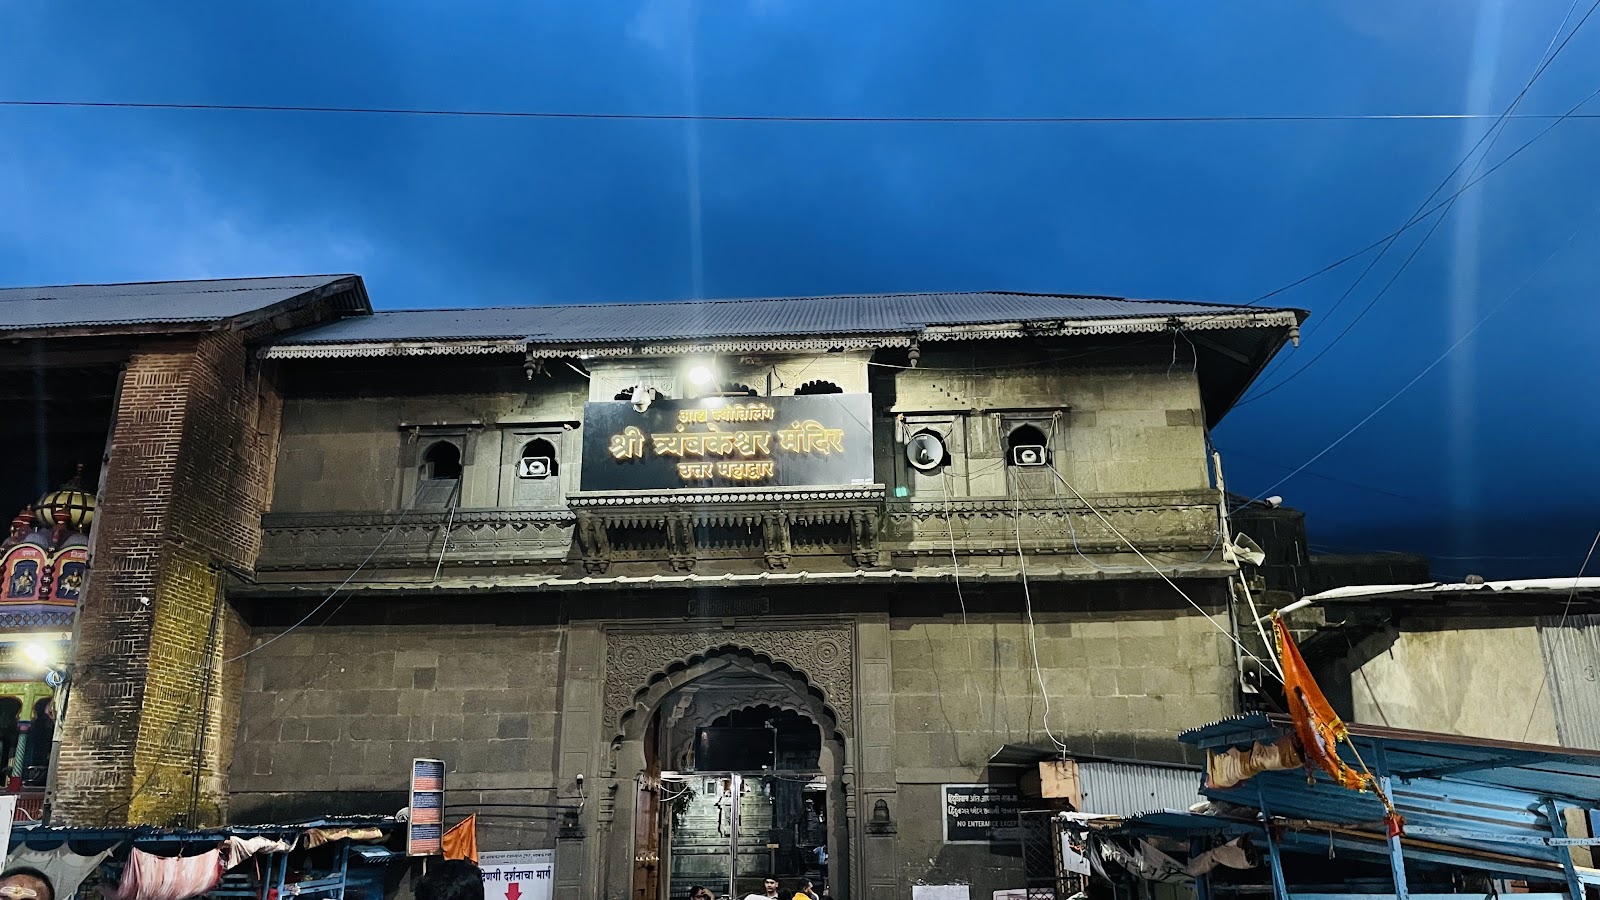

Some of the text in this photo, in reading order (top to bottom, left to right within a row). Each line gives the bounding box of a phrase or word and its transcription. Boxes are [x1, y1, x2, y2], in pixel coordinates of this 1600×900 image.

[608, 419, 844, 459] श्री त्र्यंबकेश्वर मंदिर
[676, 460, 774, 480] उत्तर महाद्वार
[956, 820, 966, 828] NO
[967, 820, 999, 828] ENTERANCE
[504, 866, 534, 882] दर्शनाचा
[536, 865, 551, 880] मार्ग
